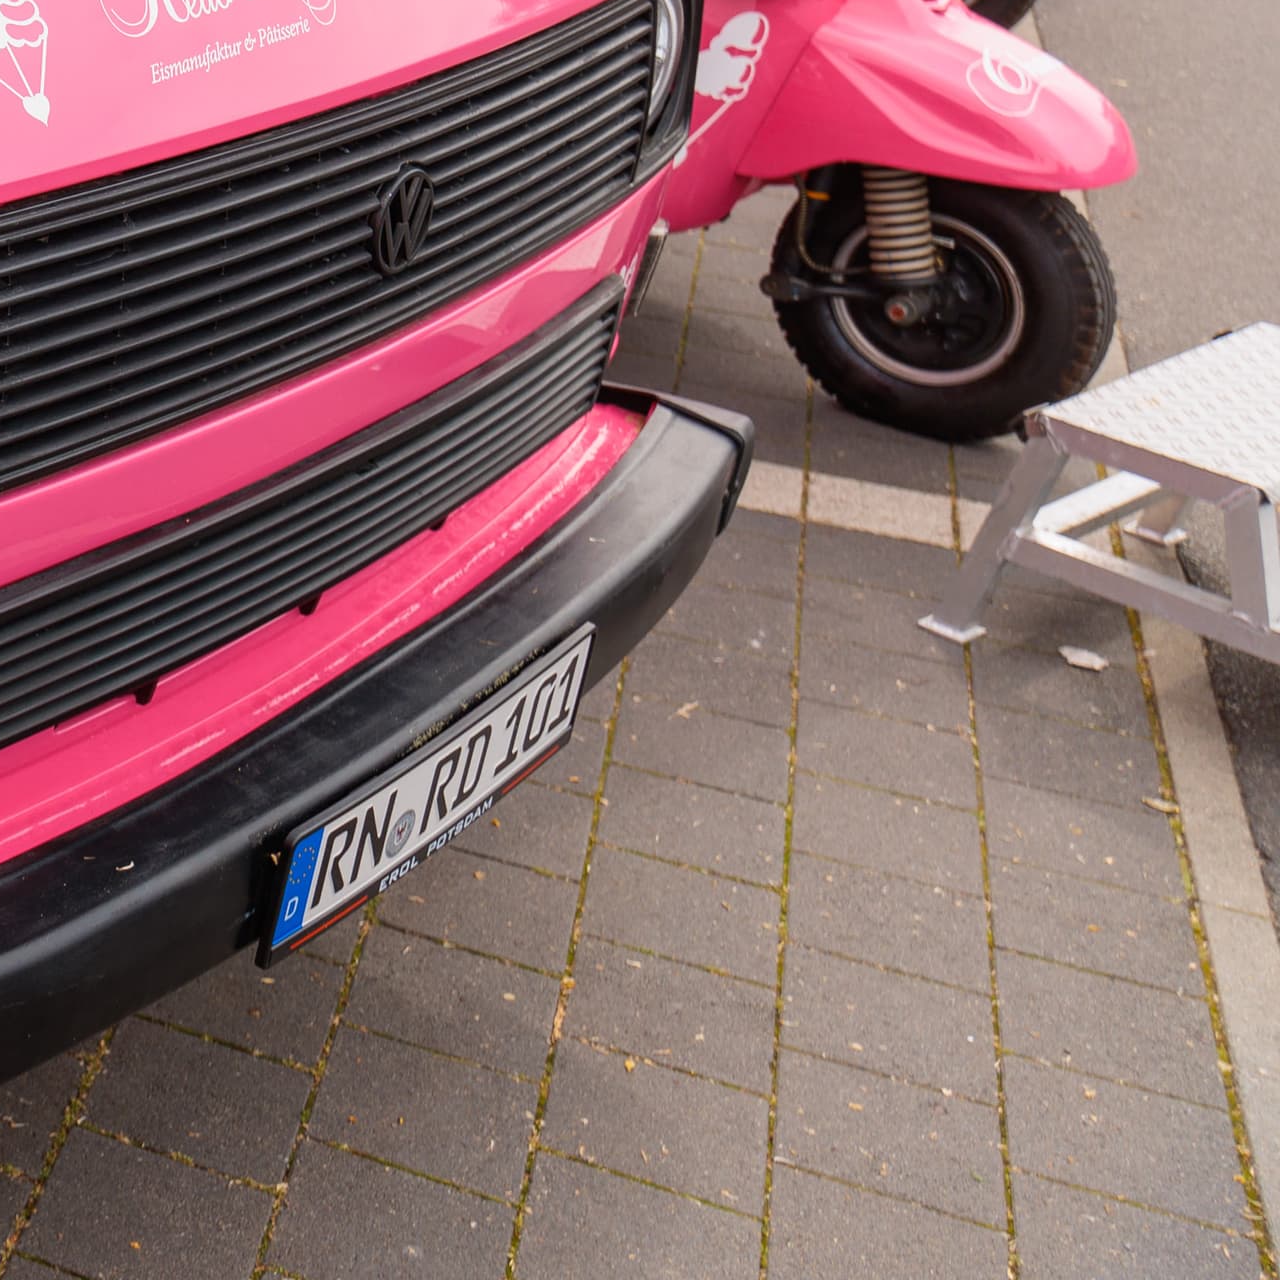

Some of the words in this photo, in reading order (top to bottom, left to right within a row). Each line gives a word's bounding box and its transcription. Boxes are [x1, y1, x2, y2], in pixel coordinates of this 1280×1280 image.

[150, 39, 242, 85] Eismanufaktur
[243, 33, 257, 53] &
[257, 16, 311, 49] Pâtisserie
[284, 896, 299, 922] D
[311, 789, 397, 909] RN
[419, 724, 492, 835] RD
[493, 654, 580, 777] 101
[378, 859, 419, 893] EROL
[426, 796, 494, 856] POTSDAM
